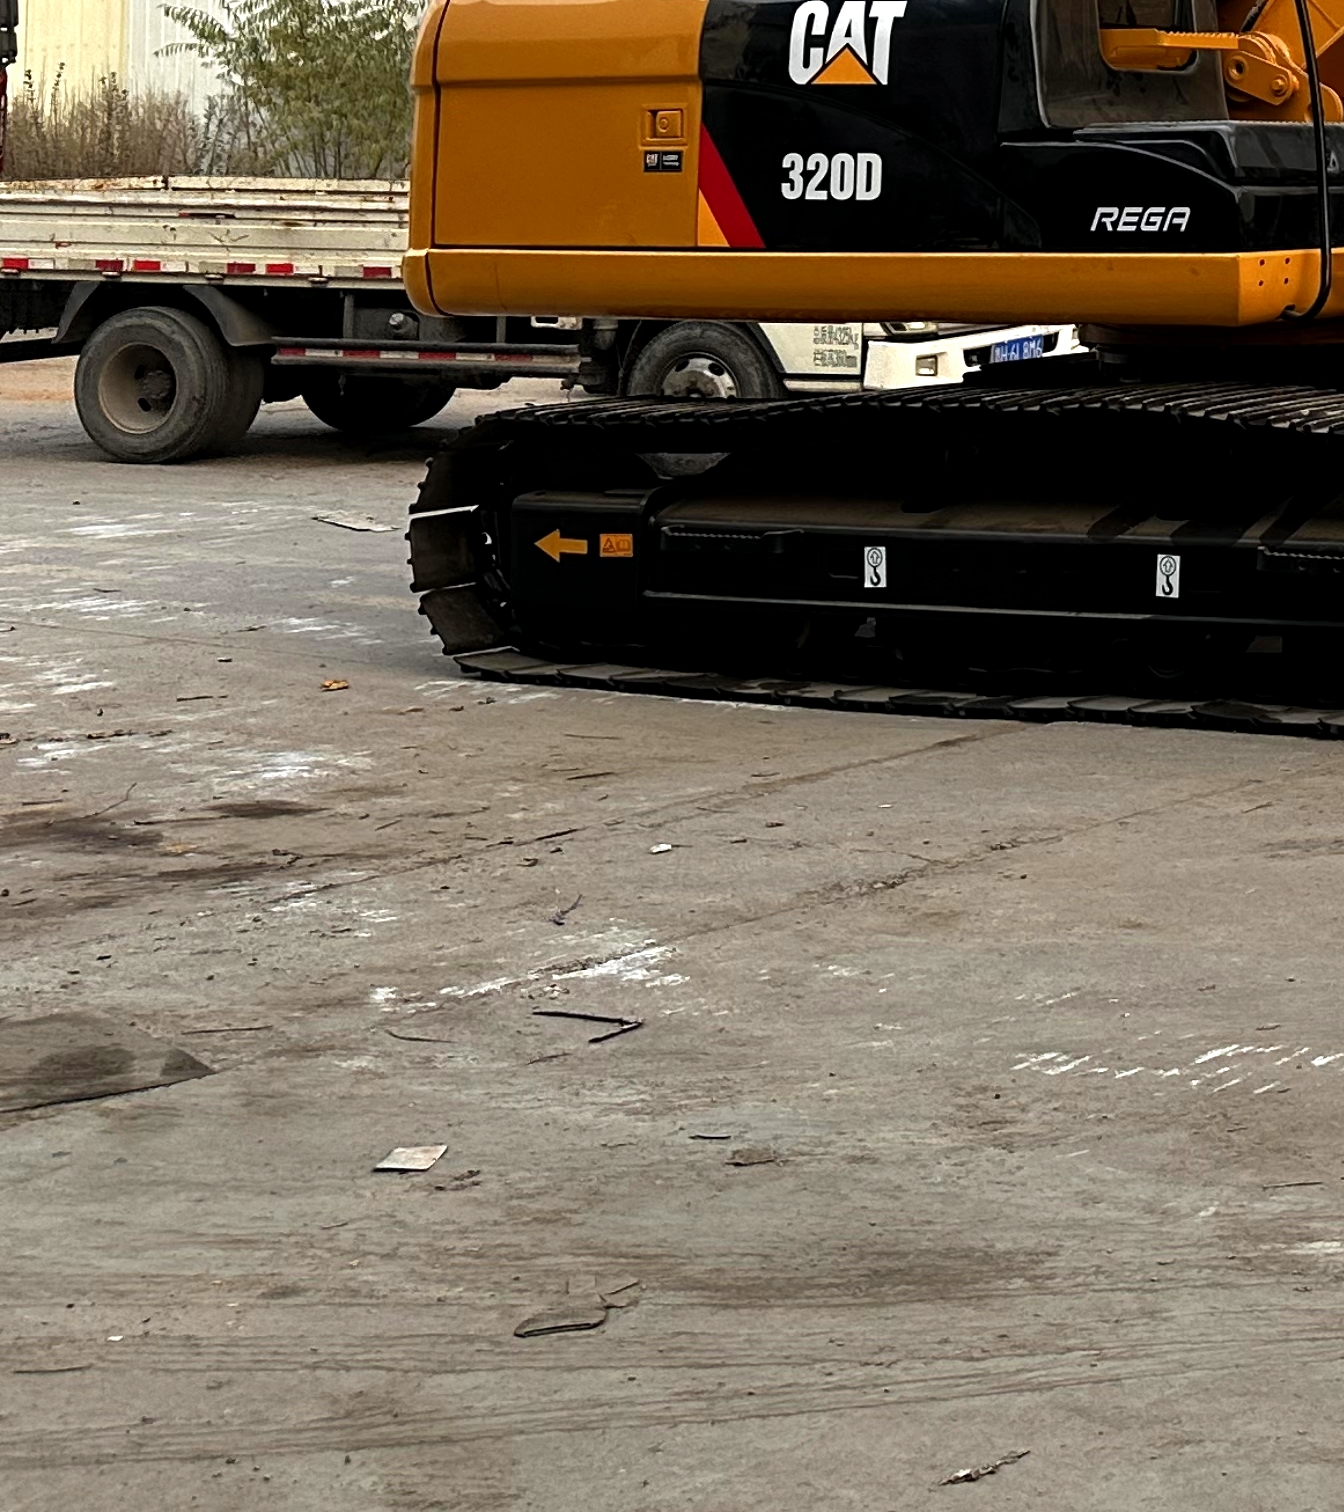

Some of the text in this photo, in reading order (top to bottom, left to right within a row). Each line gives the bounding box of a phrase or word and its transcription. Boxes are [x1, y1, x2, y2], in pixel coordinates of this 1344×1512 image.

[788, 0, 908, 85] CAT
[781, 152, 883, 201] 320D
[1090, 206, 1191, 232] REGA
